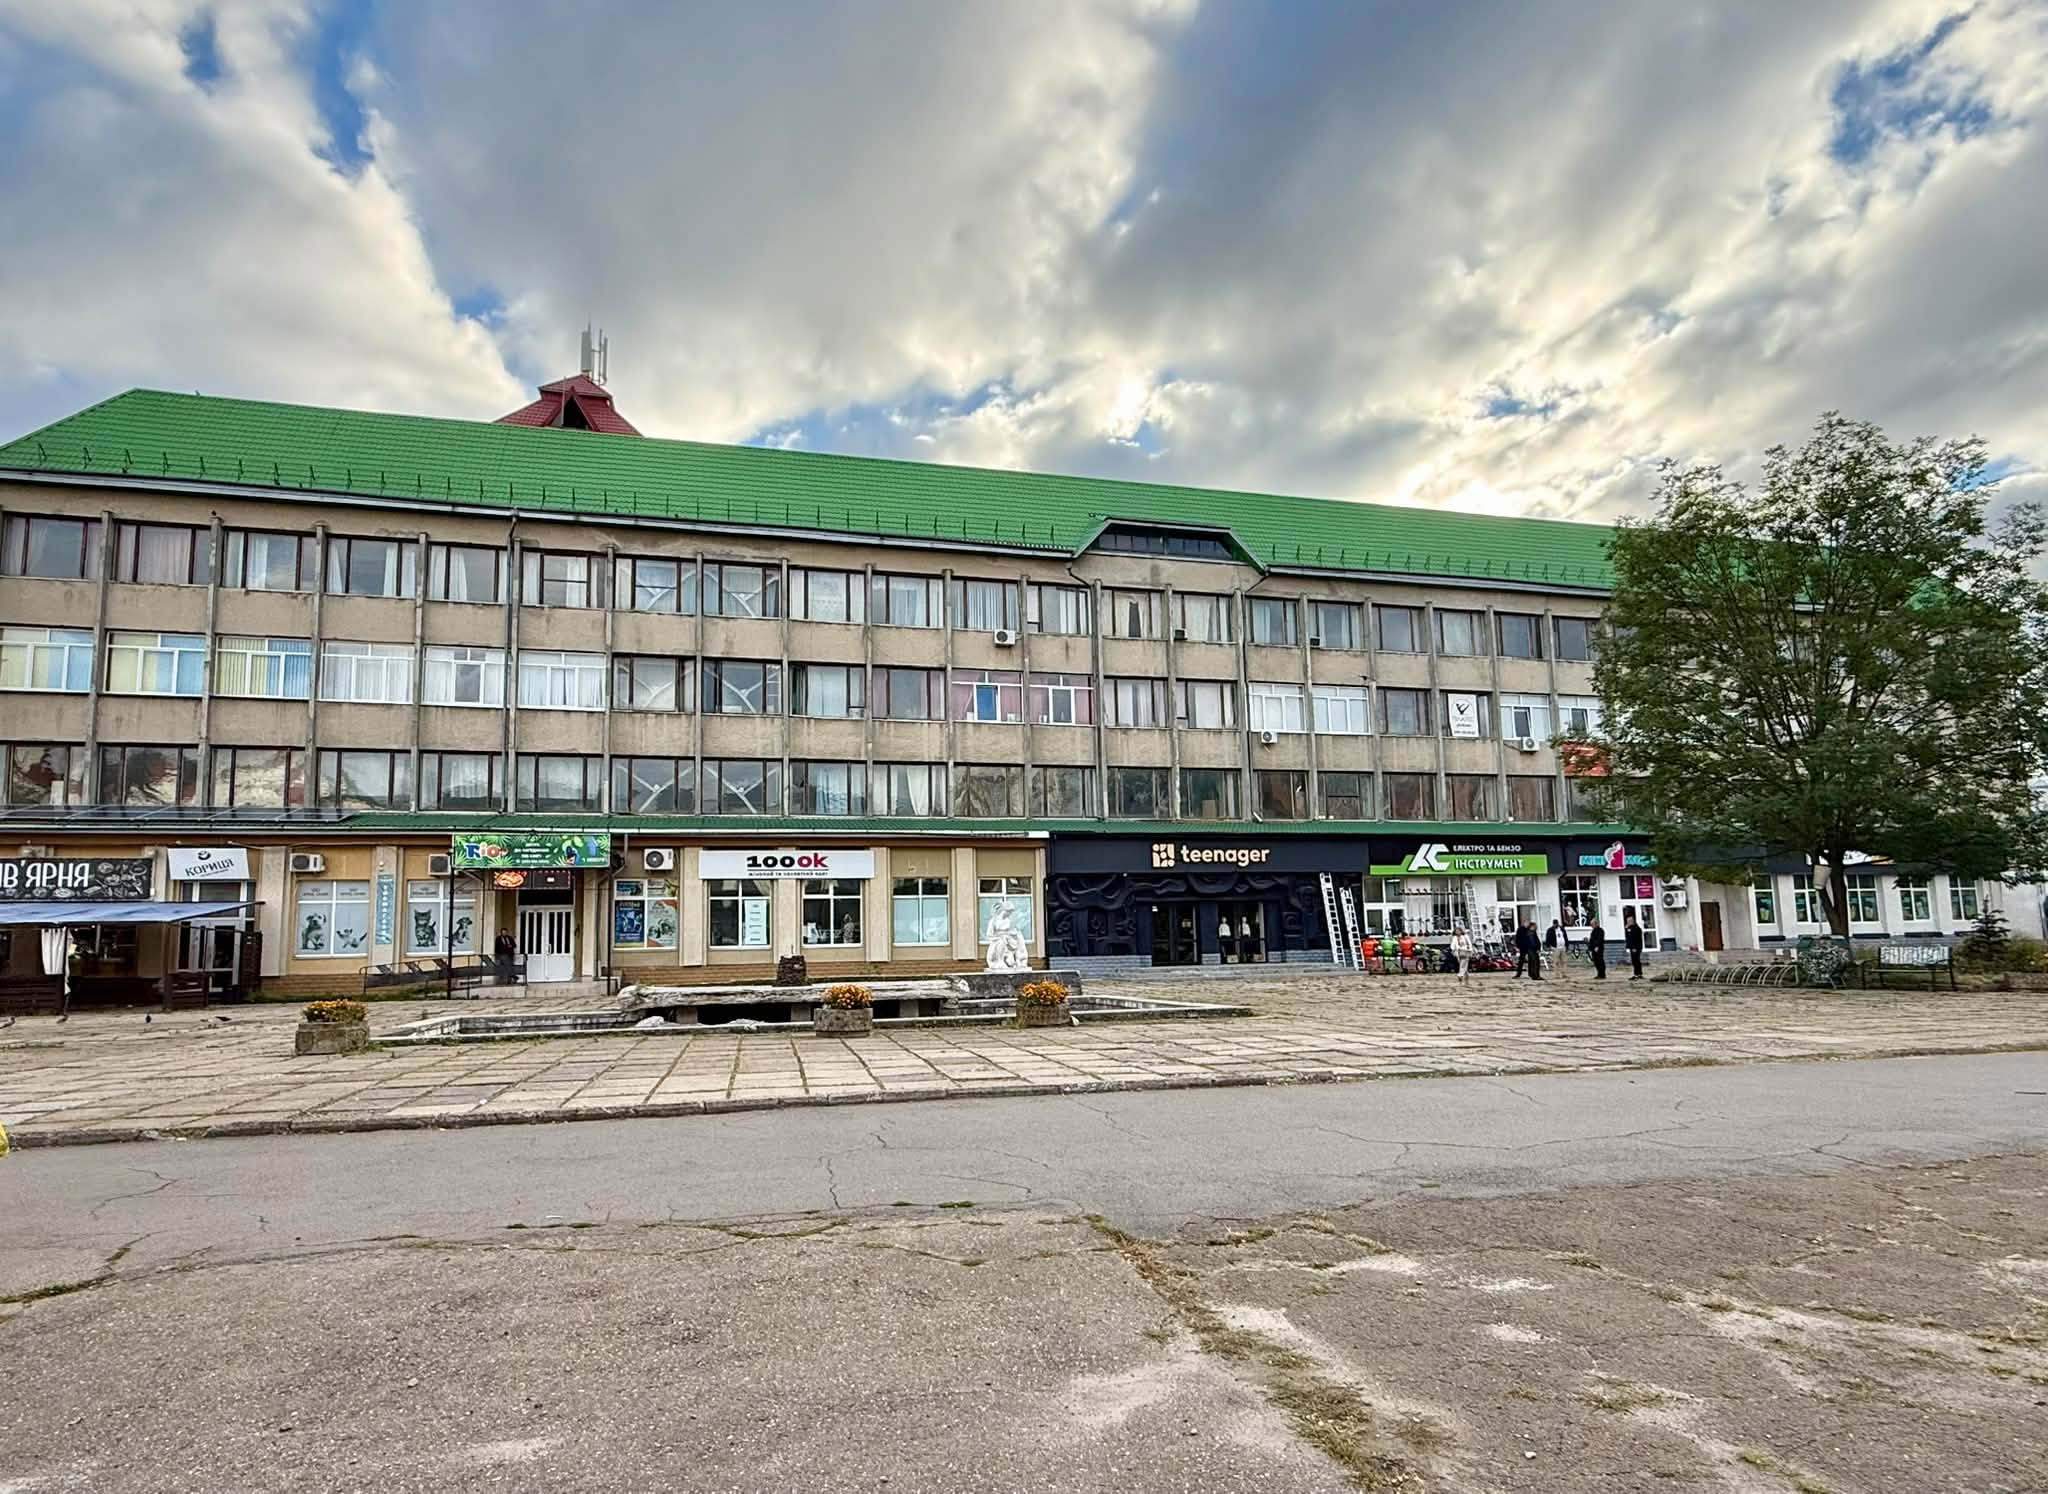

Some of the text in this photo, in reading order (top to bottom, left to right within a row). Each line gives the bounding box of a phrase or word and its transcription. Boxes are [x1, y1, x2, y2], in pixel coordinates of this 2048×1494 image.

[1487, 844, 1495, 852] ТА
[1181, 845, 1270, 867] teenager
[184, 859, 234, 877] КОРИЦЯ
[1455, 858, 1524, 869] ІНСТРУМЕНТ
